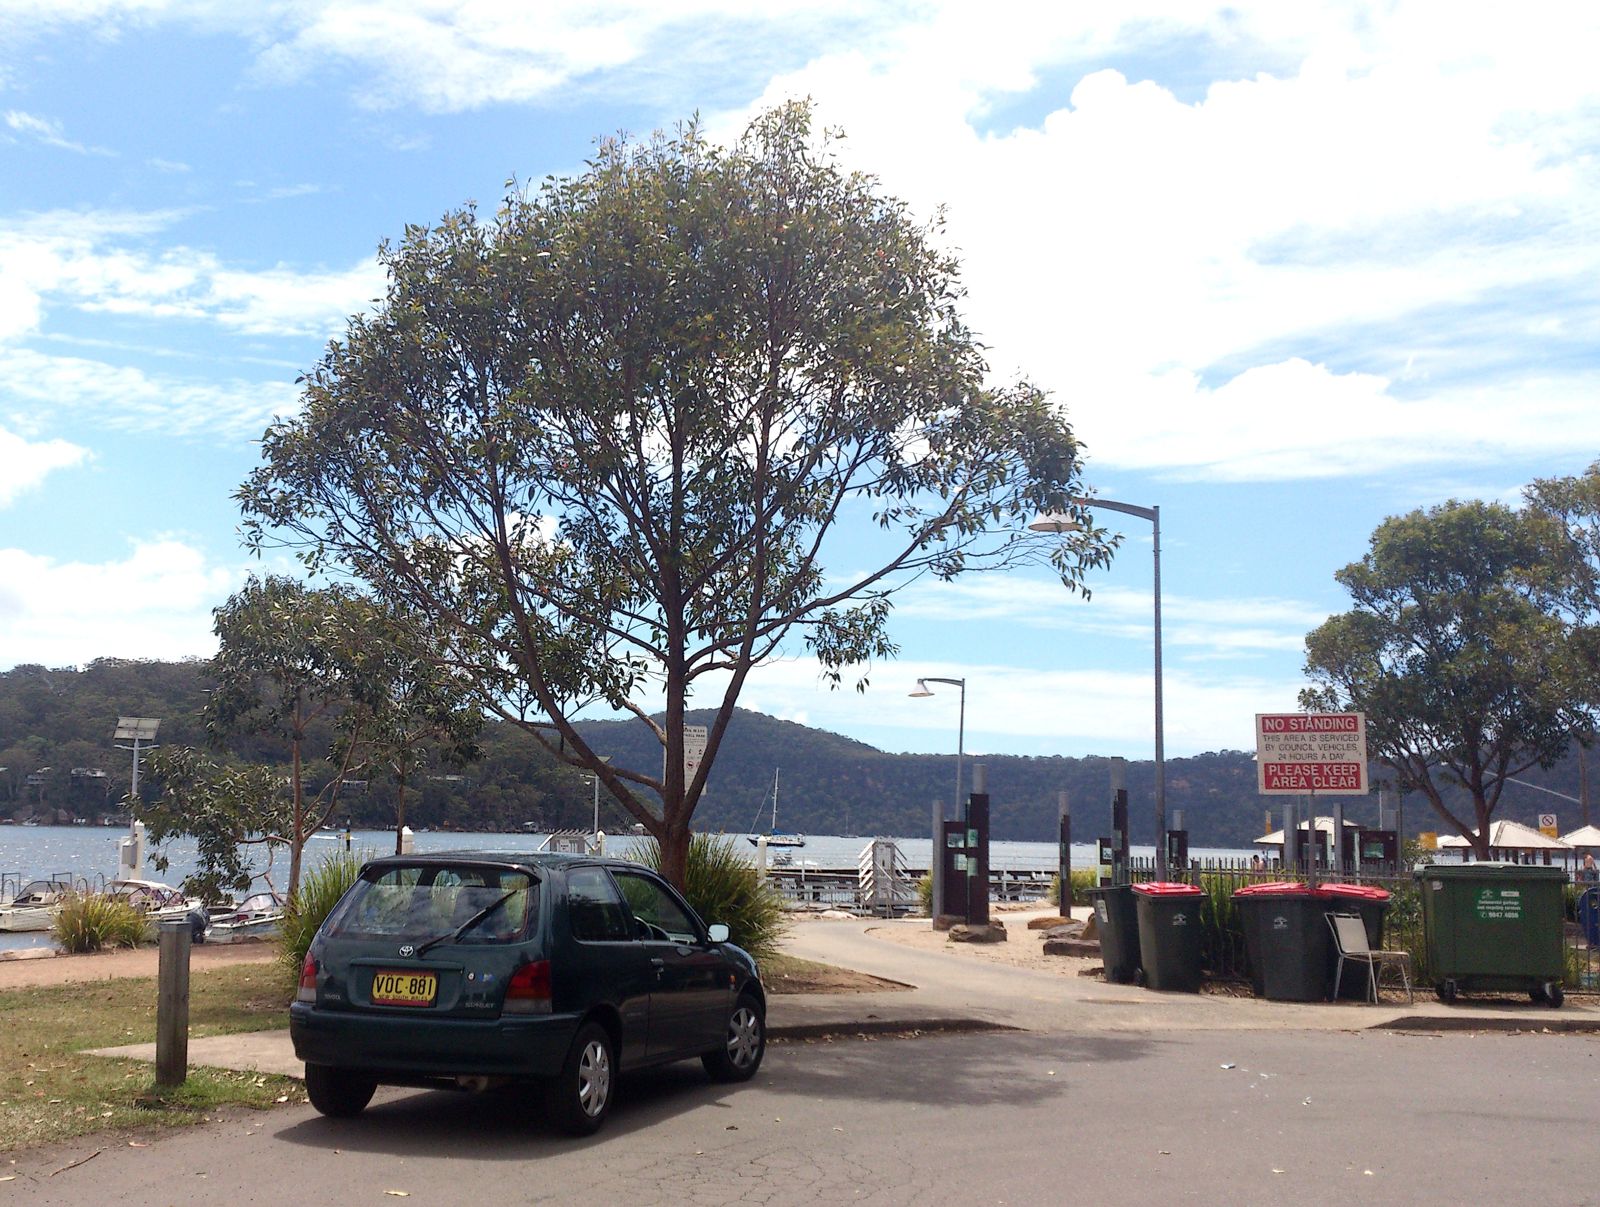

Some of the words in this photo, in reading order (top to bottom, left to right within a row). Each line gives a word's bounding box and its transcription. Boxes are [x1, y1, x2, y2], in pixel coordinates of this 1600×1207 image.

[1265, 719, 1285, 731] NO
[1289, 717, 1355, 731] STANDING
[1263, 734, 1281, 742] THIS
[1284, 734, 1306, 742] AREA
[1309, 734, 1317, 742] IS
[1319, 734, 1359, 742] SERVICED
[1265, 743, 1275, 752] BY
[1278, 743, 1315, 752] COUNCIL
[1317, 743, 1358, 752] VEHICLES
[1278, 753, 1287, 761] 24
[1289, 752, 1318, 761] HOURS
[1321, 753, 1327, 761] A
[1329, 753, 1345, 761] DAY
[1269, 765, 1319, 777] PLEASE
[1323, 765, 1358, 776] KEEP
[1272, 776, 1308, 788] AREA
[1312, 776, 1357, 788] CLEAR
